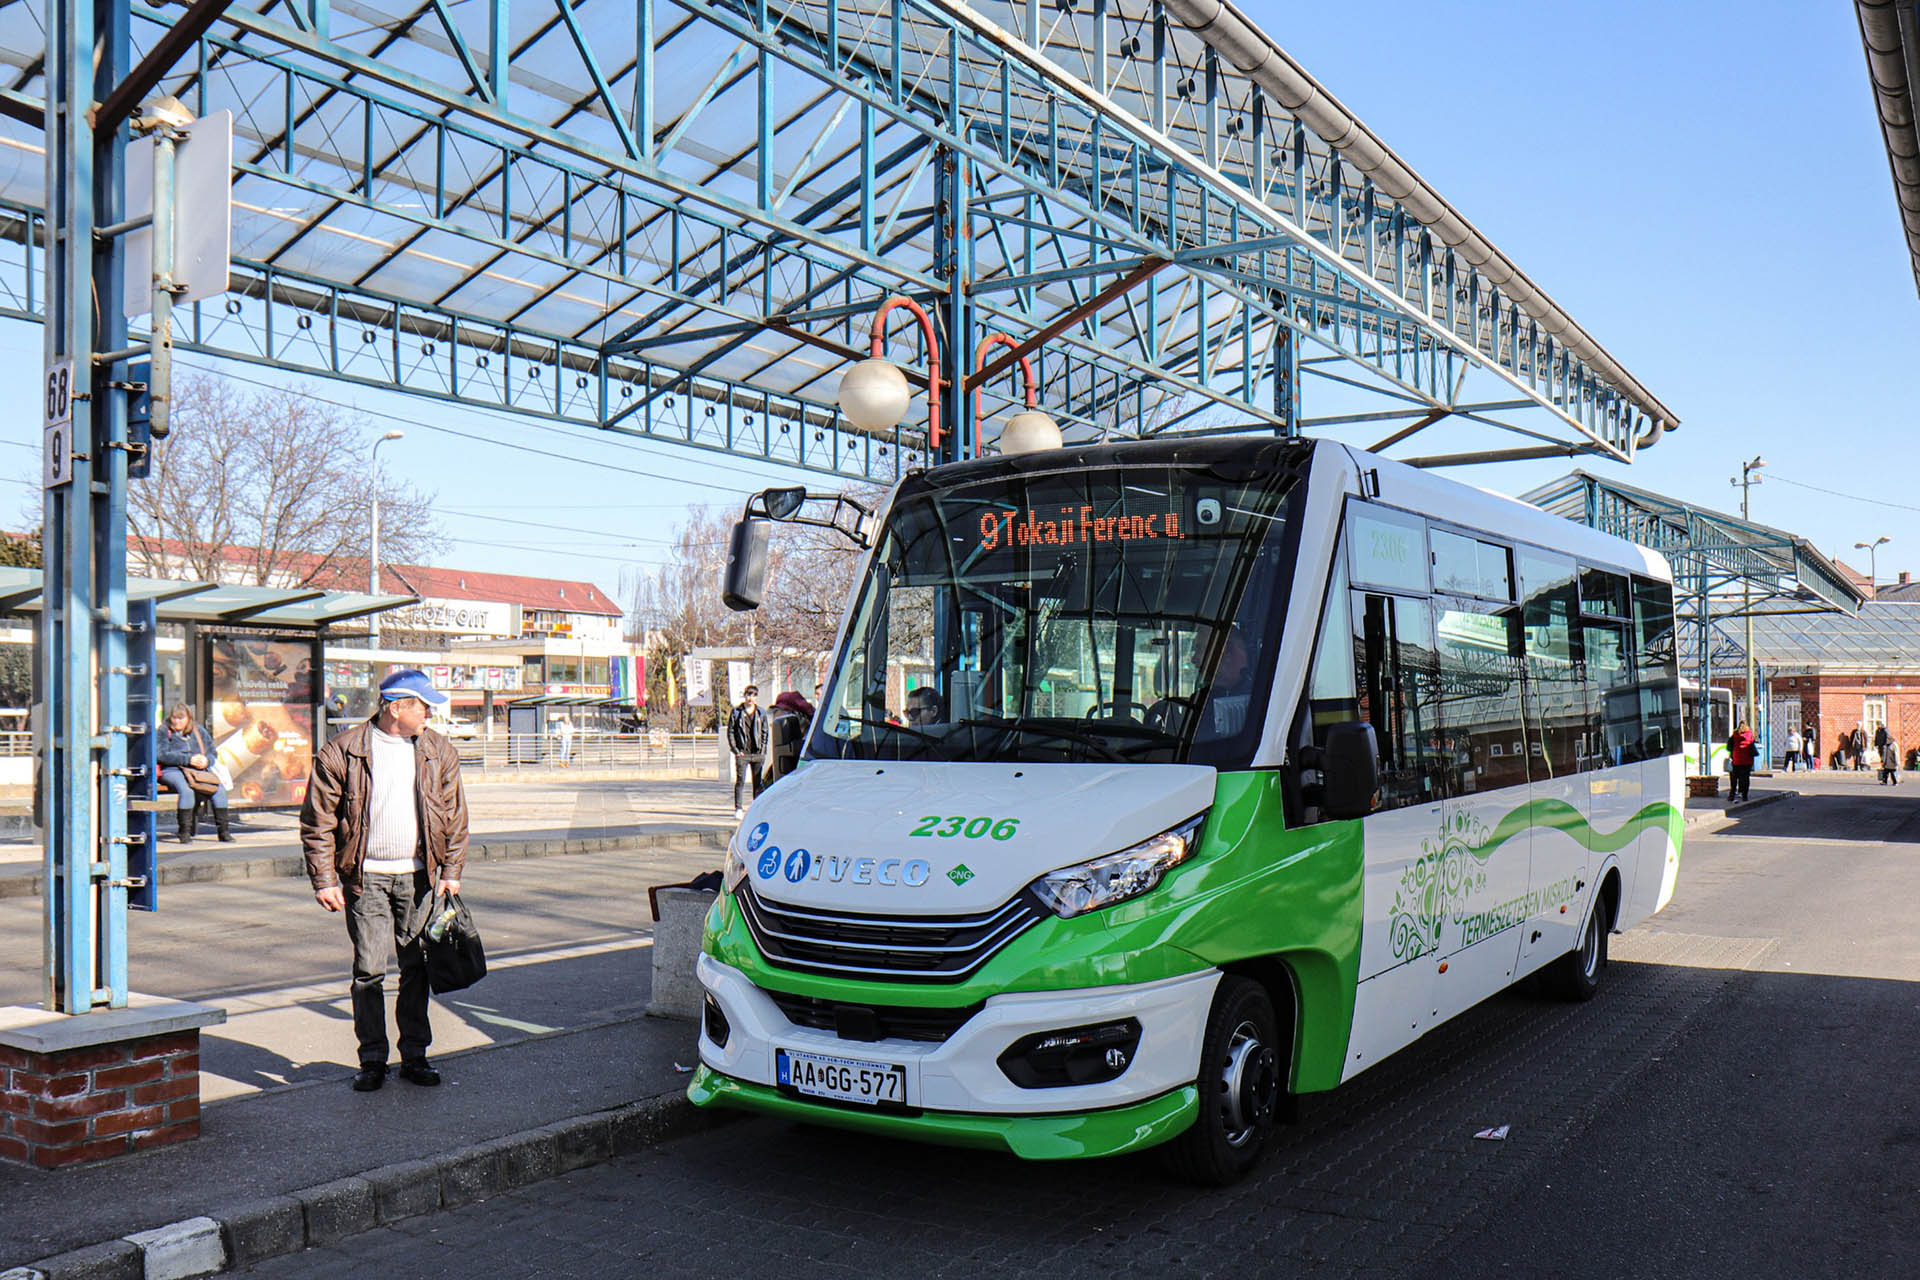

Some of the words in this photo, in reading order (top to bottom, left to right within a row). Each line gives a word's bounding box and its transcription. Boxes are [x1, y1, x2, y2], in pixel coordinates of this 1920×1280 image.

[47, 367, 68, 420] 68
[52, 430, 62, 479] 9
[980, 512, 999, 550] 9
[1002, 507, 1075, 546] Tokaji
[1079, 505, 1158, 543] Ferenc
[1370, 528, 1408, 563] 2306
[909, 815, 1021, 842] 2306
[810, 854, 931, 887] IVECO
[949, 870, 973, 880] CNG
[781, 1072, 788, 1081] H
[793, 1060, 817, 1087] AA
[825, 1065, 898, 1099] GG-577
